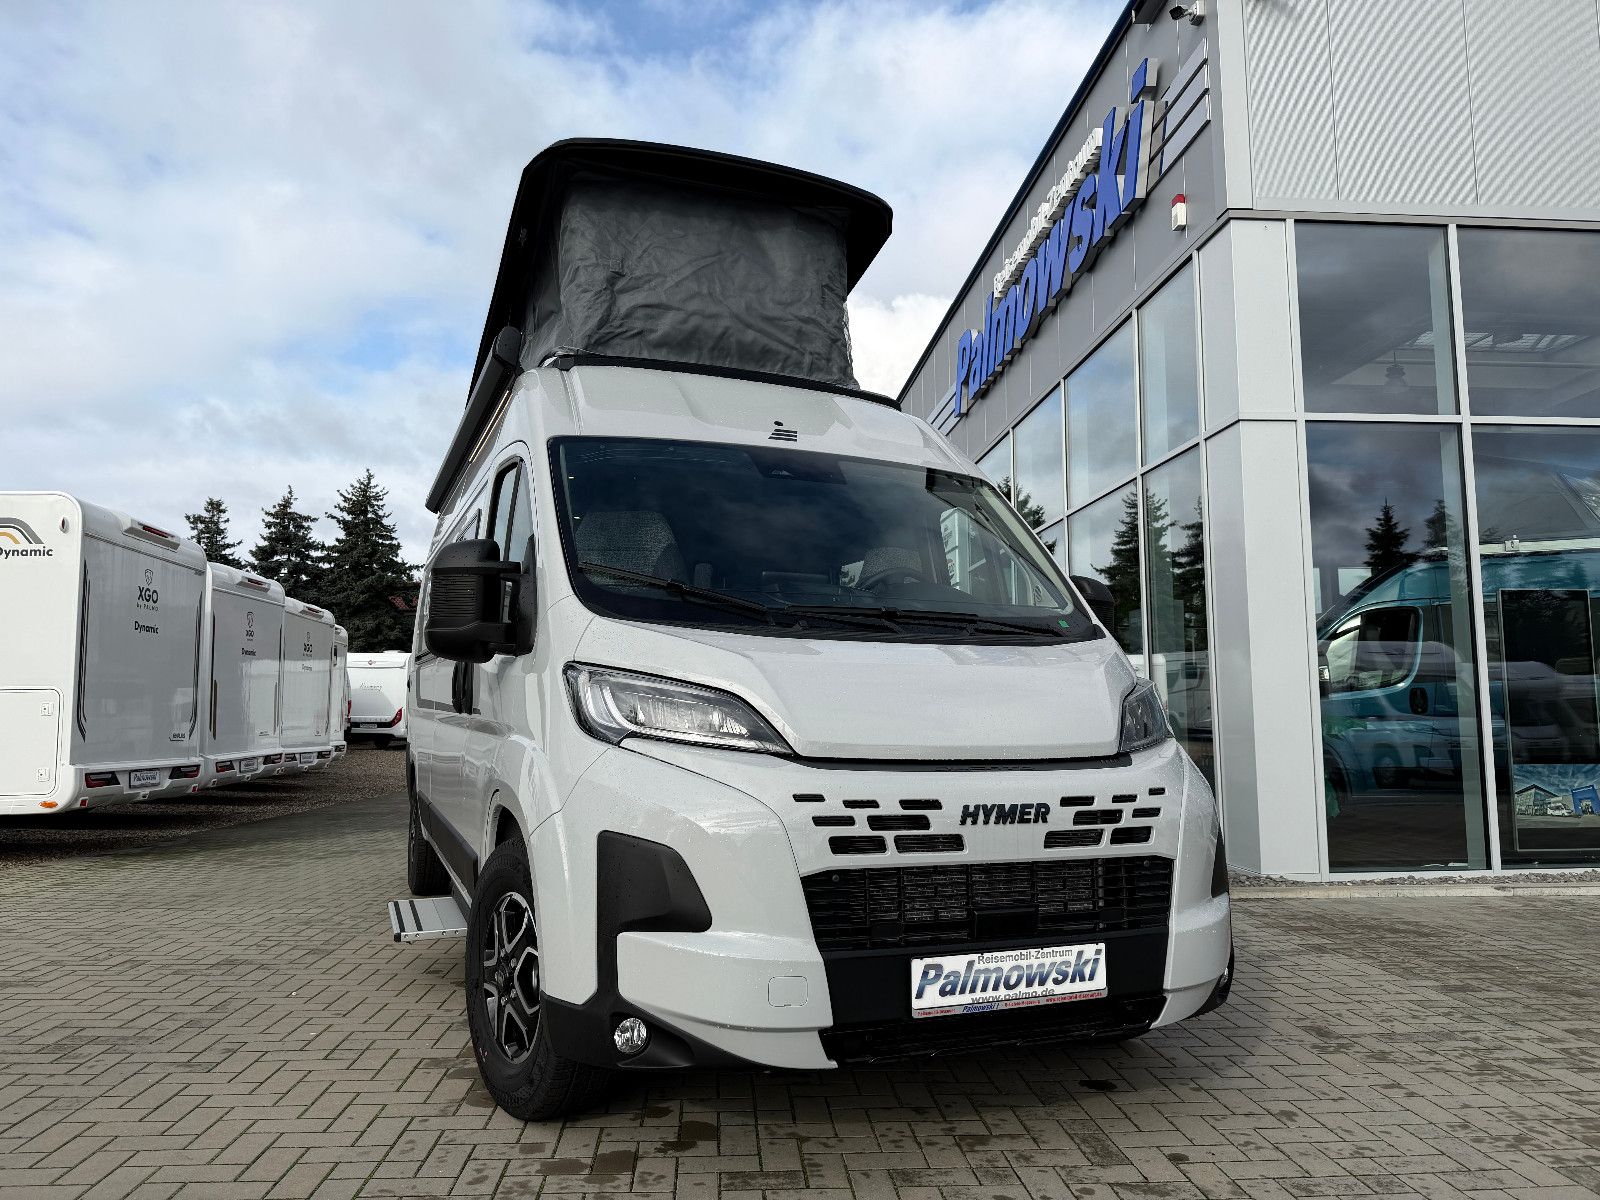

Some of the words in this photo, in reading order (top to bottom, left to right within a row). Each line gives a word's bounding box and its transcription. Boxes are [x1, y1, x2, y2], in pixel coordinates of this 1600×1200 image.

[955, 57, 1157, 418] Palmowski
[137, 585, 159, 604] XGO
[134, 620, 159, 634] Dynamic
[959, 802, 1051, 826] HYMER
[977, 949, 1073, 965] Reisemobil-Zentrum
[914, 948, 1102, 1000] Palmowski
[970, 987, 1055, 1004] www.palmo.de
